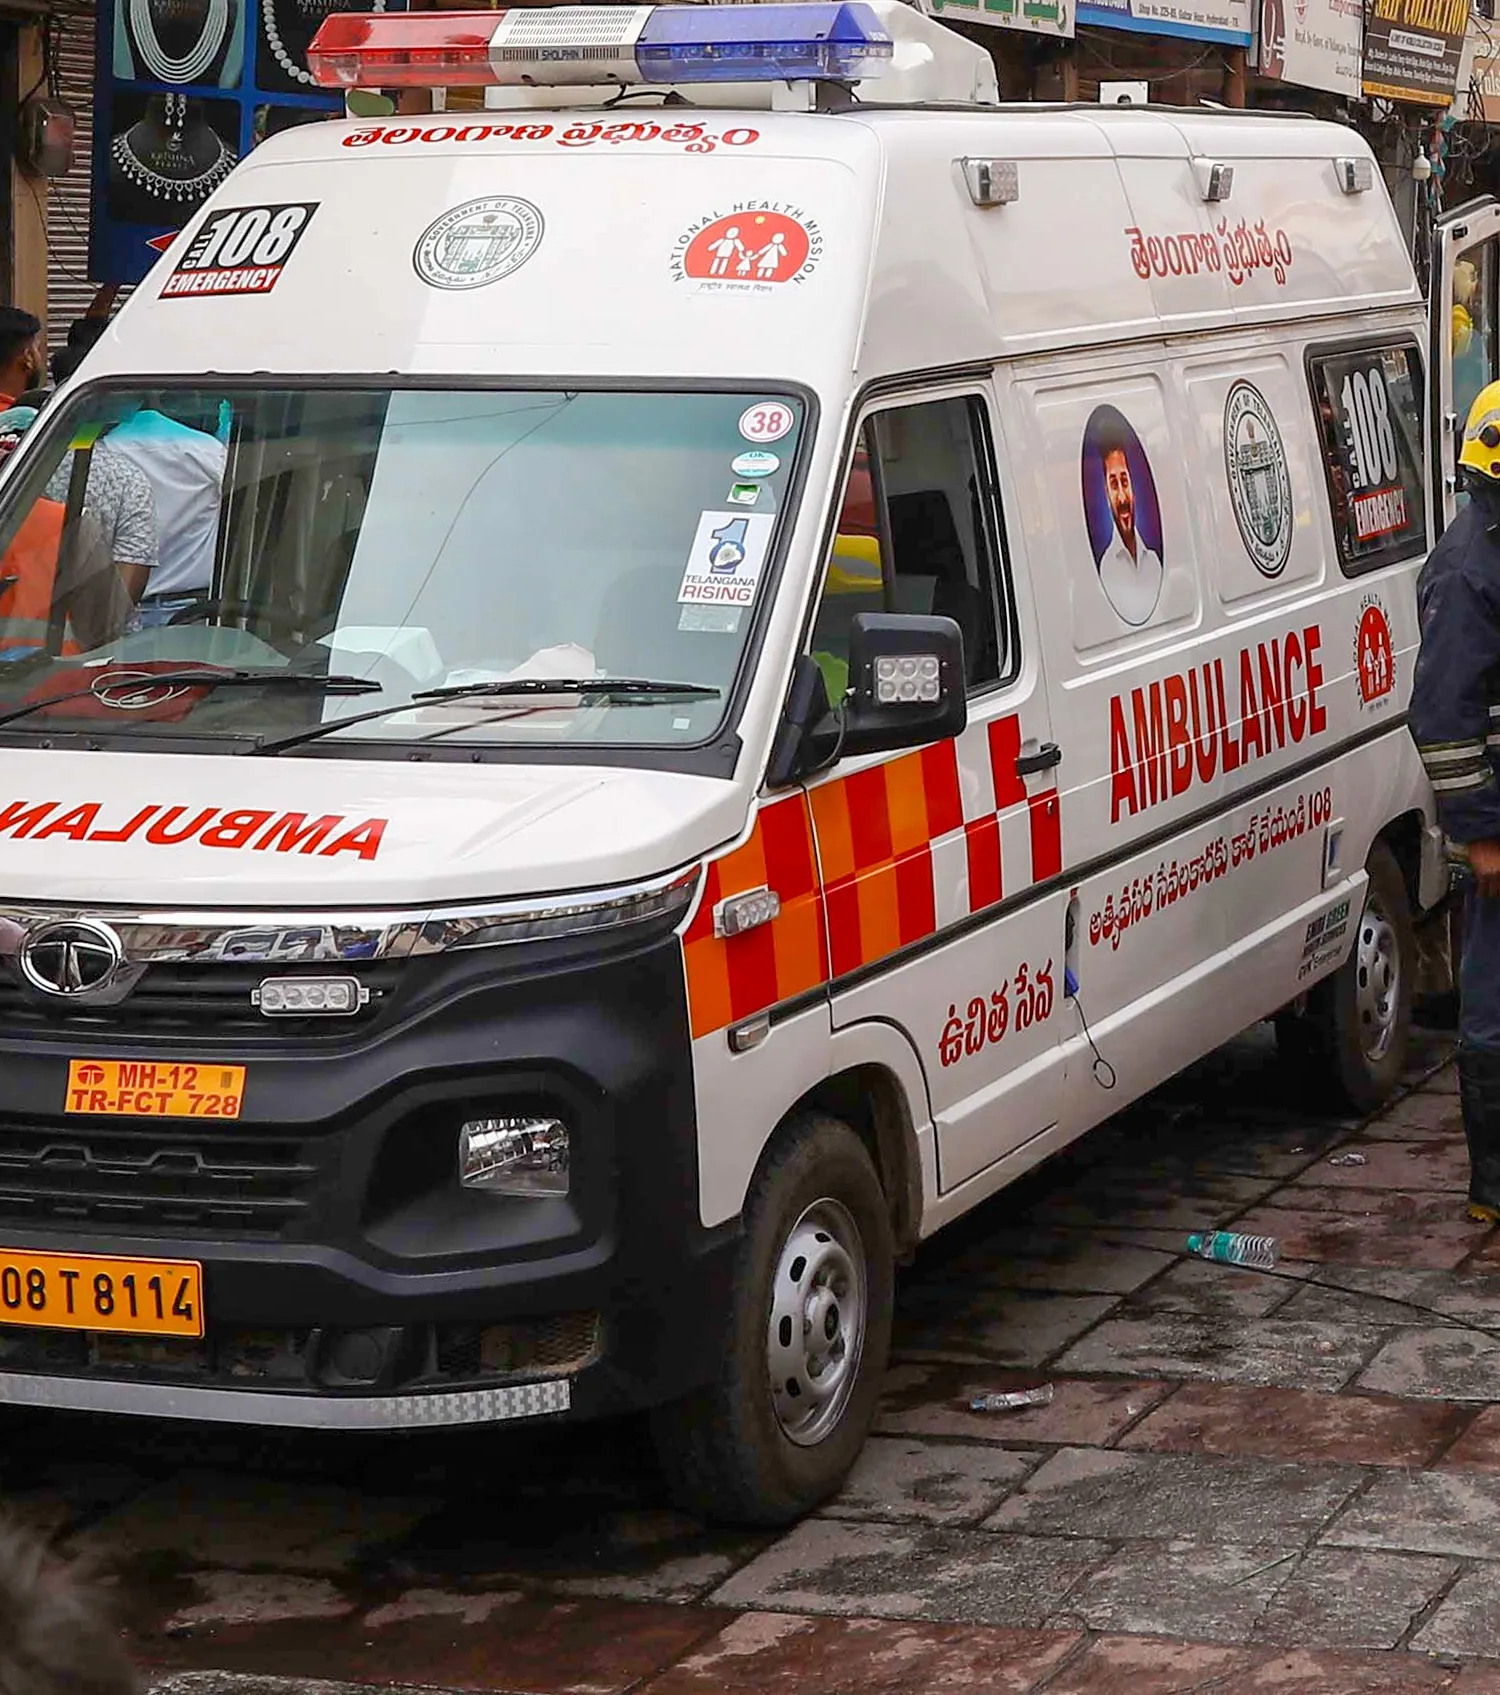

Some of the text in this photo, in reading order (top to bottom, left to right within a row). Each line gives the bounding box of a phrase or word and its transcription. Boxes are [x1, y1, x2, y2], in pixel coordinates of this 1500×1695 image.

[342, 120, 760, 153] తెలంగాణ ప్రభుత్వం
[196, 206, 307, 268] 108
[428, 203, 489, 242] GOVERNMENT
[495, 201, 508, 210] OF
[670, 200, 824, 284] NATIONAL HEALTH MISSION
[182, 232, 215, 270] CALL
[1124, 215, 1292, 286] తెలంగాణ ప్రభుత్వం
[163, 267, 281, 294] EMERGENCY
[751, 411, 783, 434] 38
[1341, 368, 1398, 489] 108
[1354, 489, 1407, 537] EMERGENCY
[681, 585, 752, 601] RISING
[684, 574, 755, 587] TELANGANA
[1110, 624, 1327, 824] AMBULANCE
[1089, 874, 1154, 952] అత్యవసర
[1231, 815, 1259, 867] కాల్
[1259, 794, 1306, 855] చేయండి
[1308, 786, 1332, 831] 108
[938, 958, 1054, 1067] ఉచిత సేవ
[118, 1064, 198, 1090] MH-12
[71, 1089, 239, 1116] TR-FCT 728
[2, 1266, 46, 1310] 08
[59, 1270, 79, 1313] T
[94, 1272, 193, 1322] 8114
